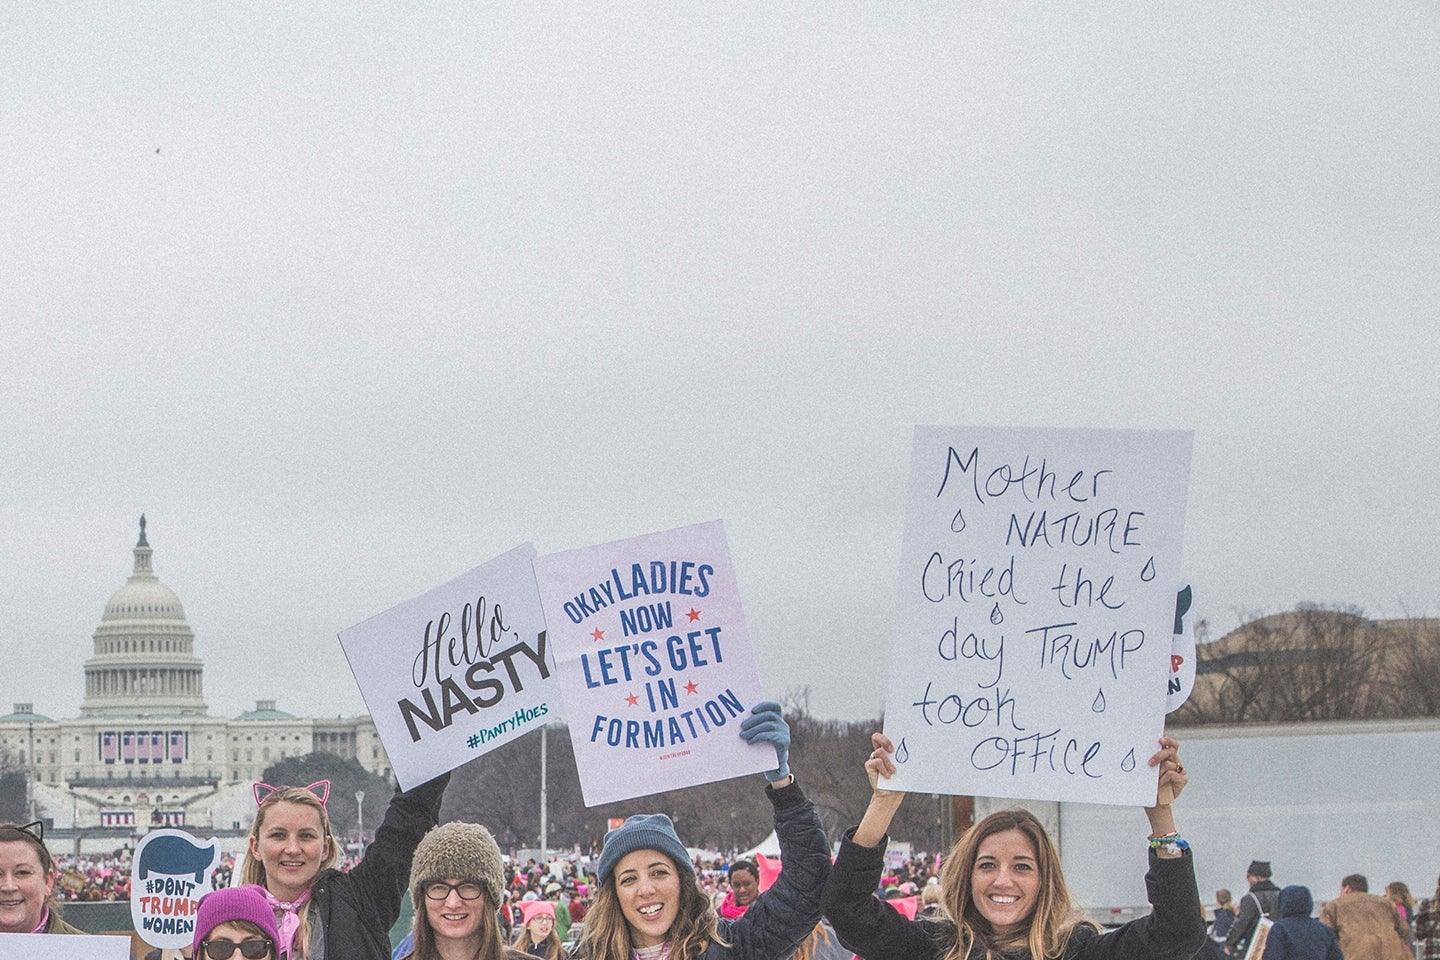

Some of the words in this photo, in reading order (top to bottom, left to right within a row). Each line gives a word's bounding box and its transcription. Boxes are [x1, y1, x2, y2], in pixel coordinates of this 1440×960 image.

[937, 446, 1113, 504] Mother
[1006, 508, 1145, 554] NATURE
[563, 580, 616, 624] OKAY
[611, 561, 714, 601] LADIES
[1051, 563, 1126, 610] the
[413, 596, 518, 687] Hello,
[620, 601, 673, 637] NOW
[581, 640, 661, 689] LET'S
[666, 627, 722, 671] GET
[938, 616, 1005, 689] day
[1025, 621, 1145, 681] TRUMP
[397, 630, 550, 742] NASTY
[645, 678, 679, 712] IN
[591, 689, 744, 748] FORMATION
[146, 877, 195, 897] #DONT
[143, 917, 193, 935] WOMEN
